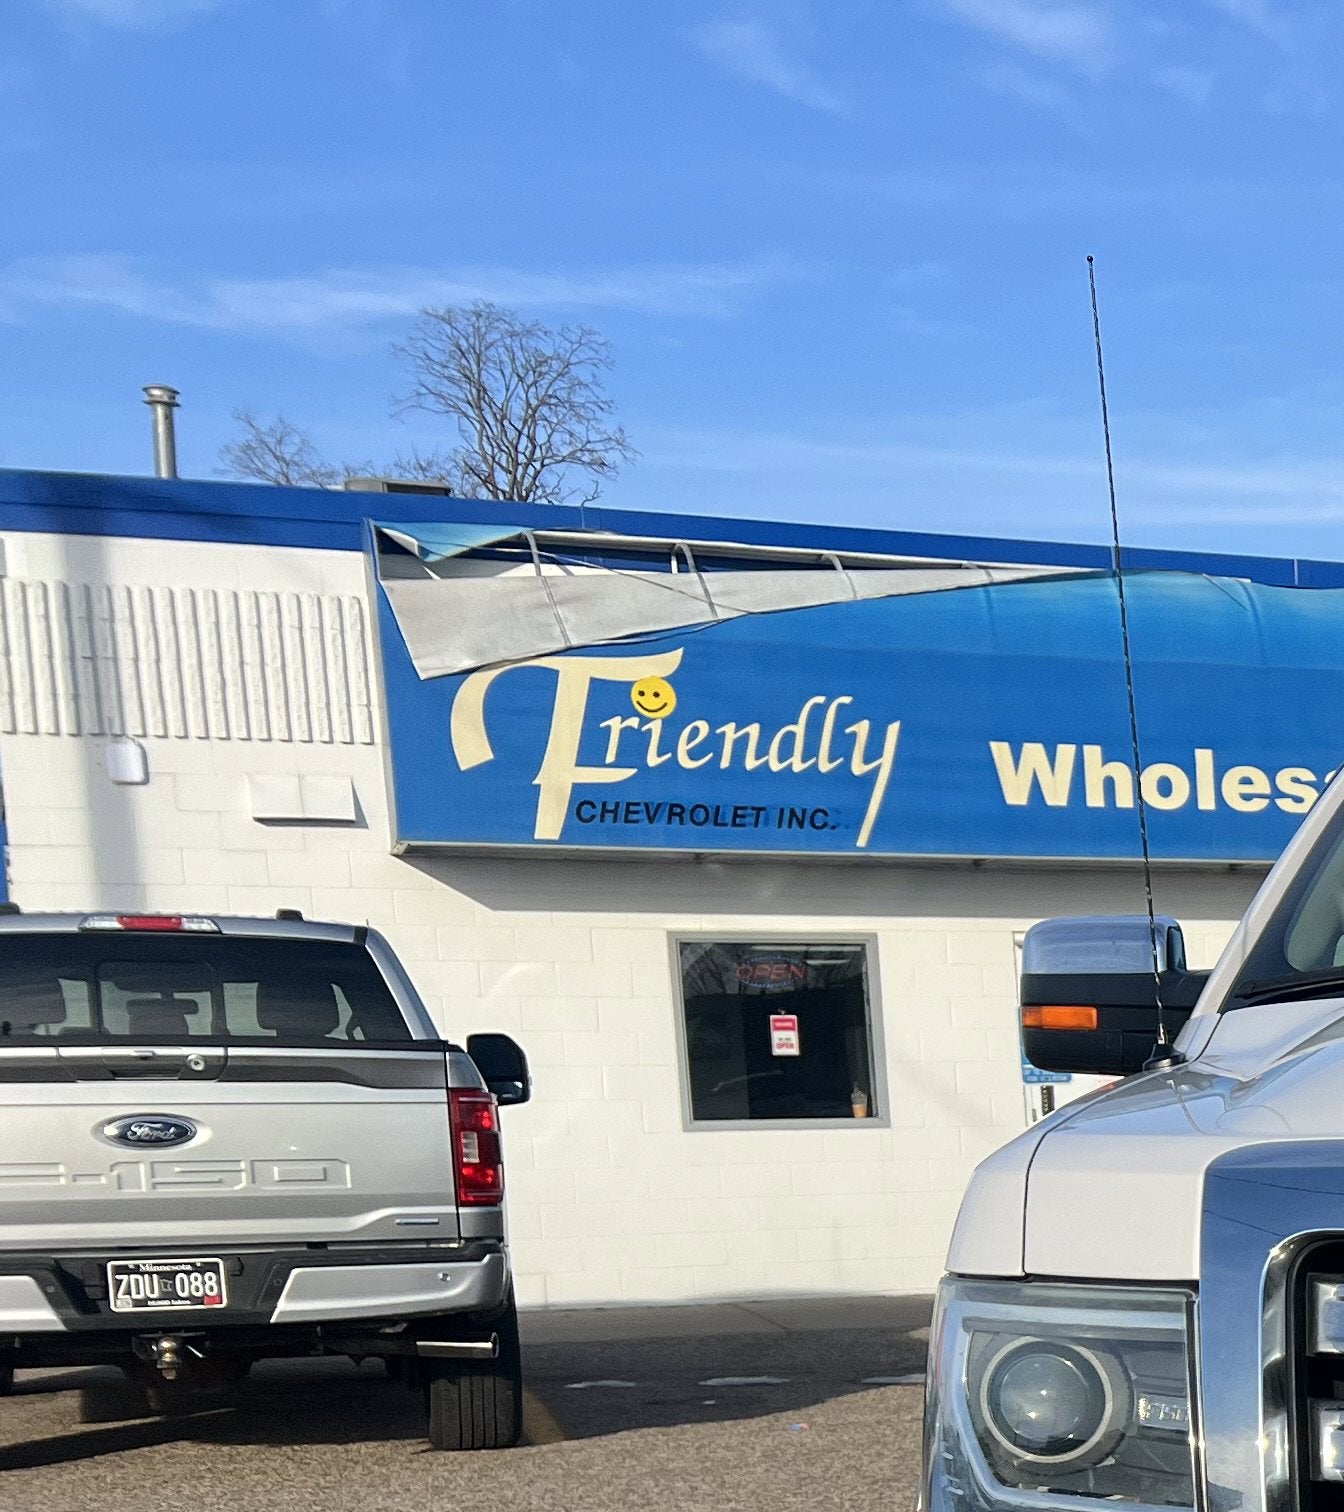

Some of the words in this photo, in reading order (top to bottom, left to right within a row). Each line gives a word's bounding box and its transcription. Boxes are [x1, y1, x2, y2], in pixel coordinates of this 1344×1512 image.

[450, 647, 901, 848] Friendly
[988, 740, 1340, 815] Wholes
[575, 799, 767, 829] CHEVROLET
[776, 806, 838, 831] INC.
[736, 963, 806, 980] OPEN
[127, 1122, 176, 1141] Ford
[139, 1263, 194, 1272] Minnesota
[115, 1274, 159, 1299] ZDU
[175, 1271, 218, 1298] 088
